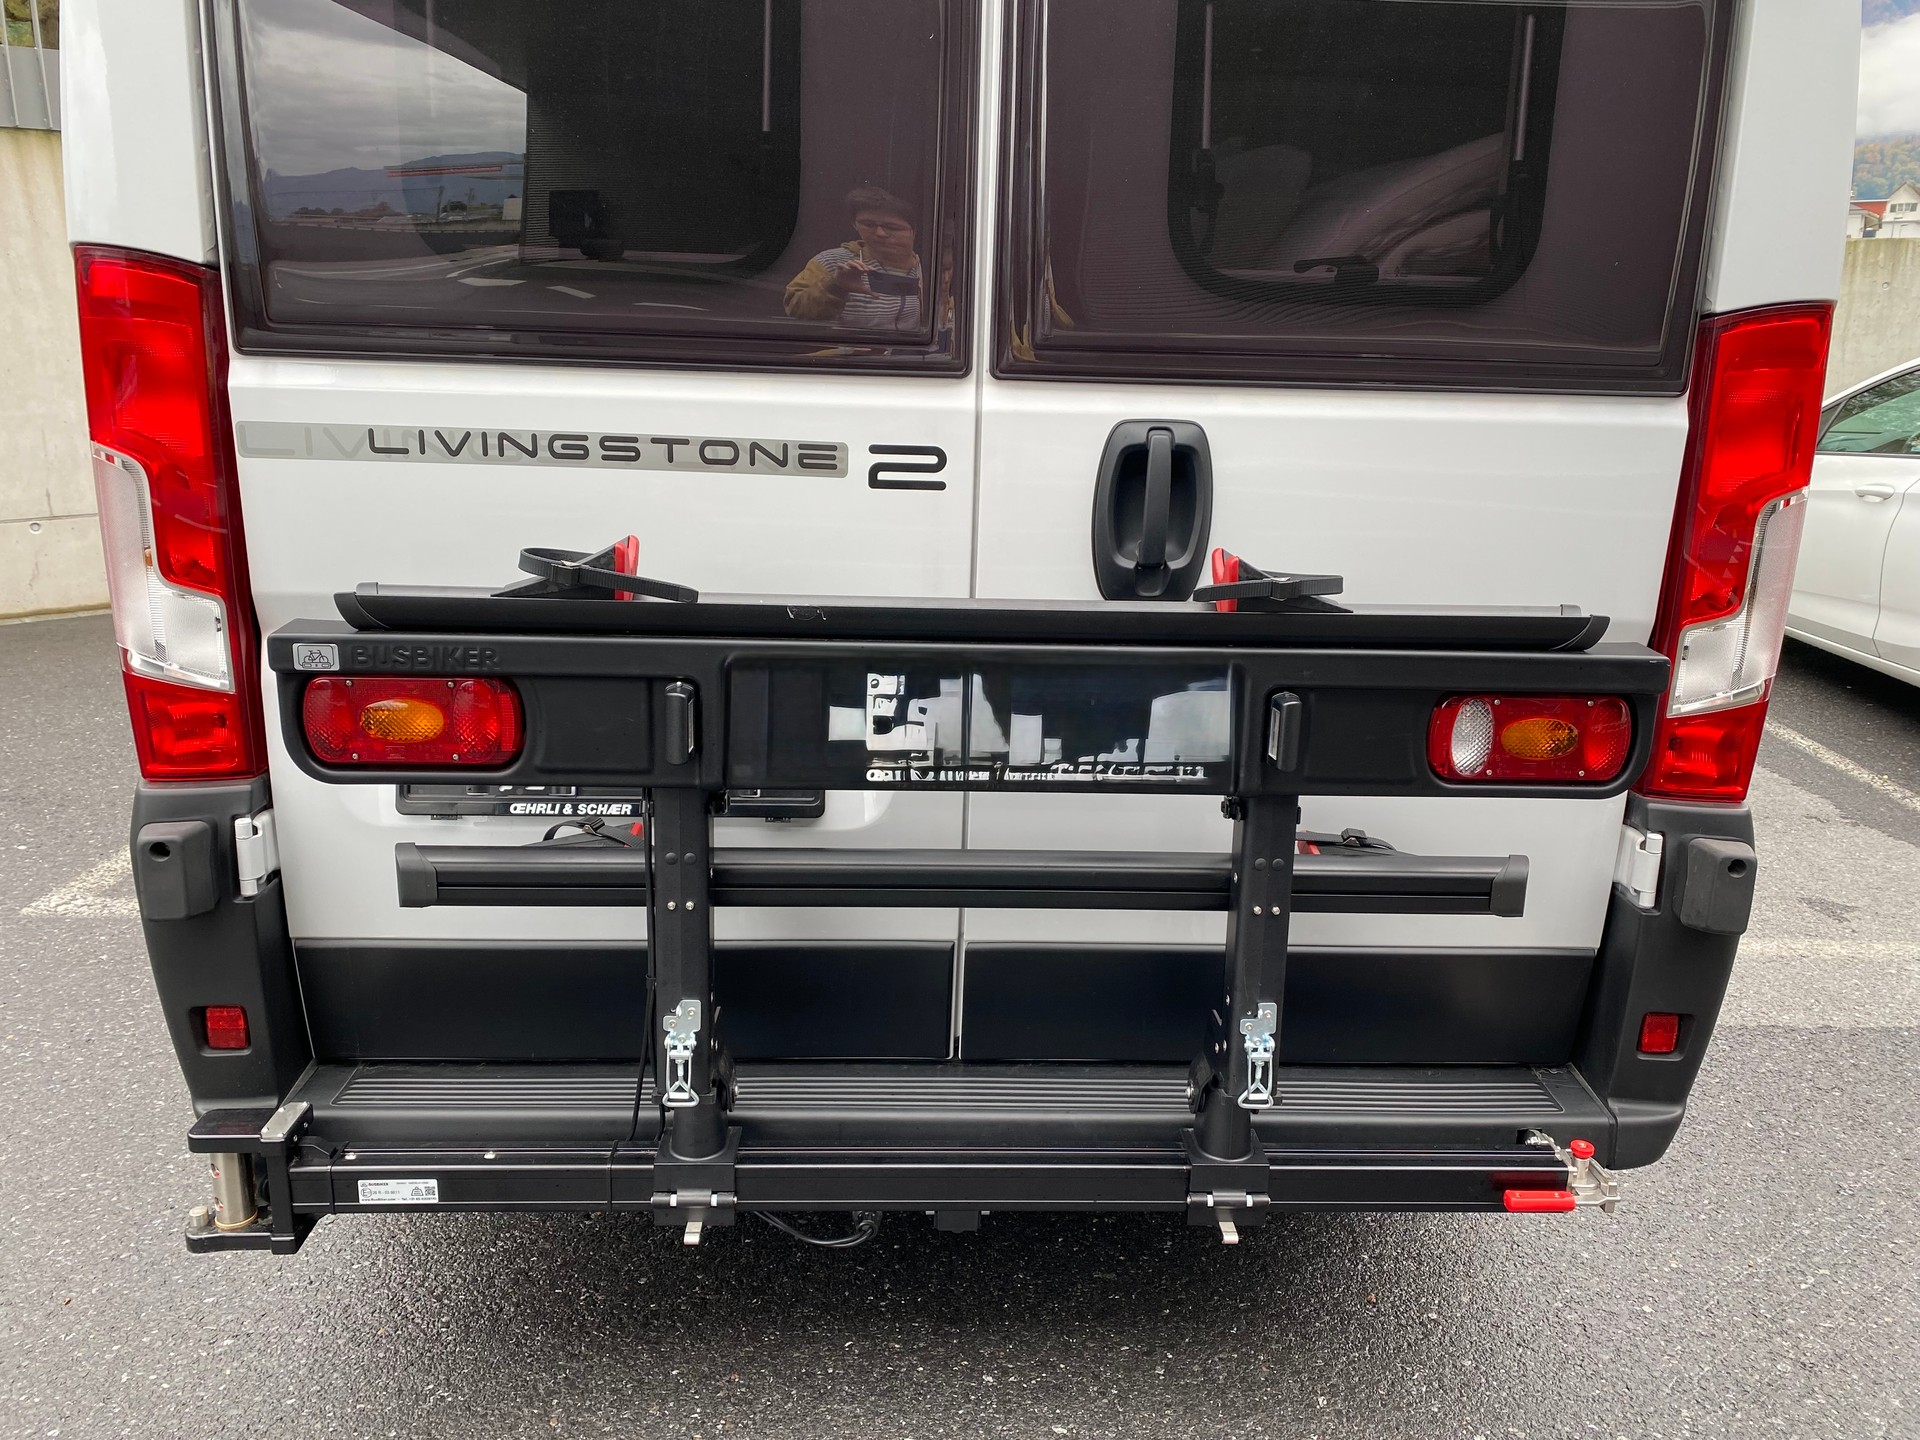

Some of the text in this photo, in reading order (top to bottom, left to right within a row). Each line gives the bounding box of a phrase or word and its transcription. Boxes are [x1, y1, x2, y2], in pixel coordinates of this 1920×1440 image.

[367, 427, 948, 491] LIVINGSTONE 2
[351, 645, 500, 670] BUSBIKER
[509, 802, 632, 816] ŒHRLI & SCHÆR
